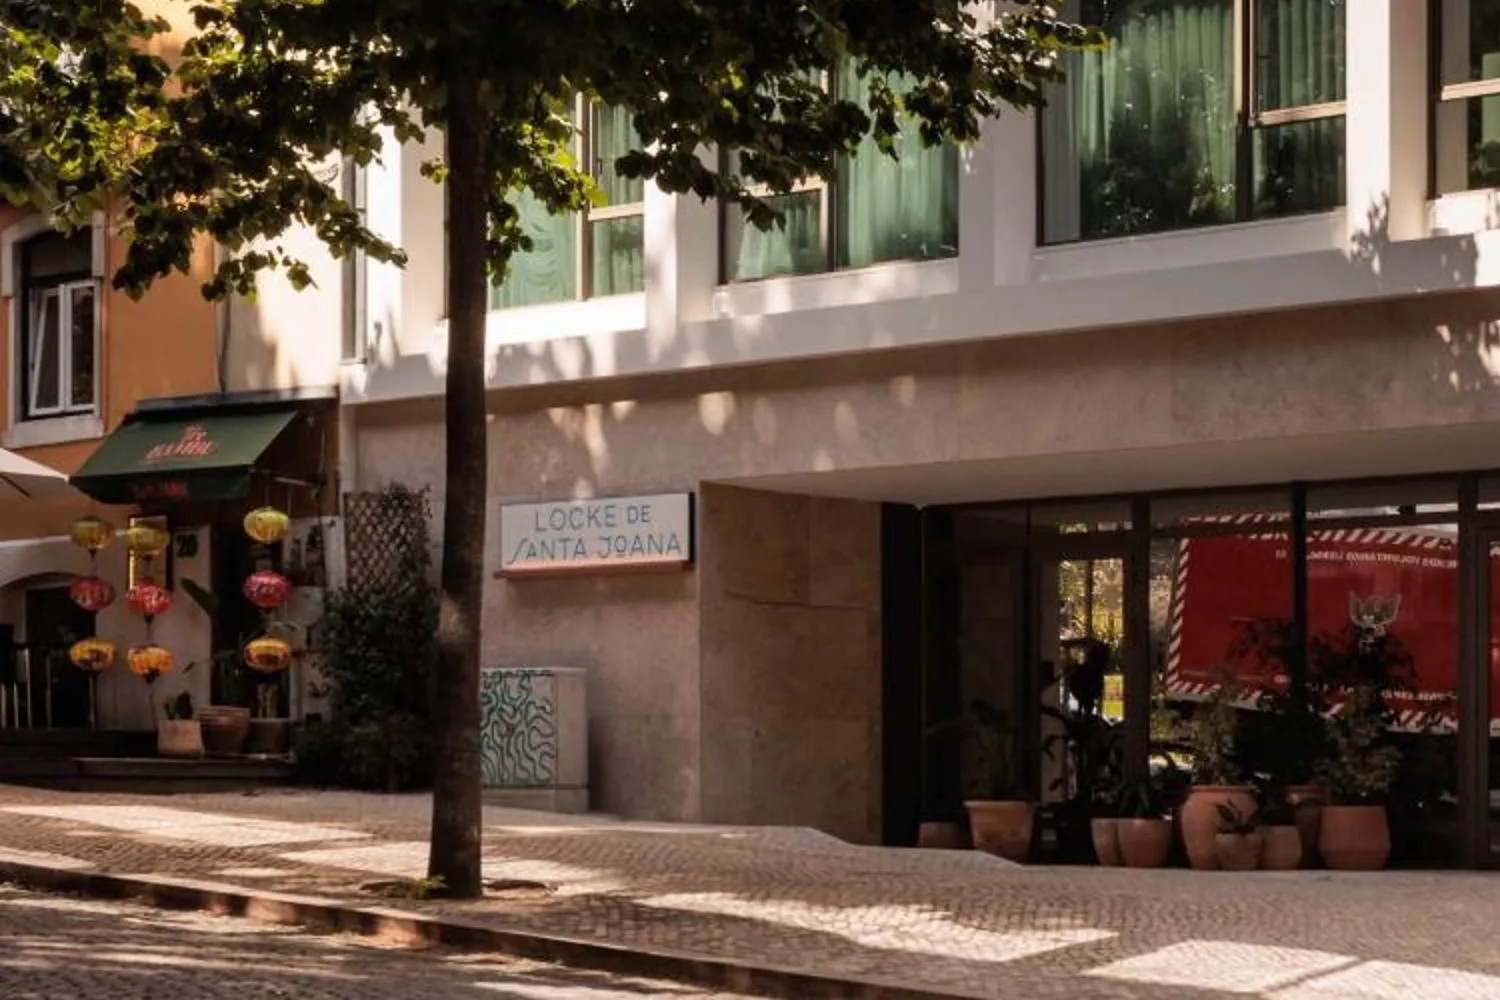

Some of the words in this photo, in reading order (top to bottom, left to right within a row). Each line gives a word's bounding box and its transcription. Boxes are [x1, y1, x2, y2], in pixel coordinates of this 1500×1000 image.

[534, 505, 617, 533] LOCKE
[626, 505, 652, 524] DE
[176, 534, 198, 558] 20
[506, 537, 588, 564] SANTA
[597, 533, 682, 559] JOANA
